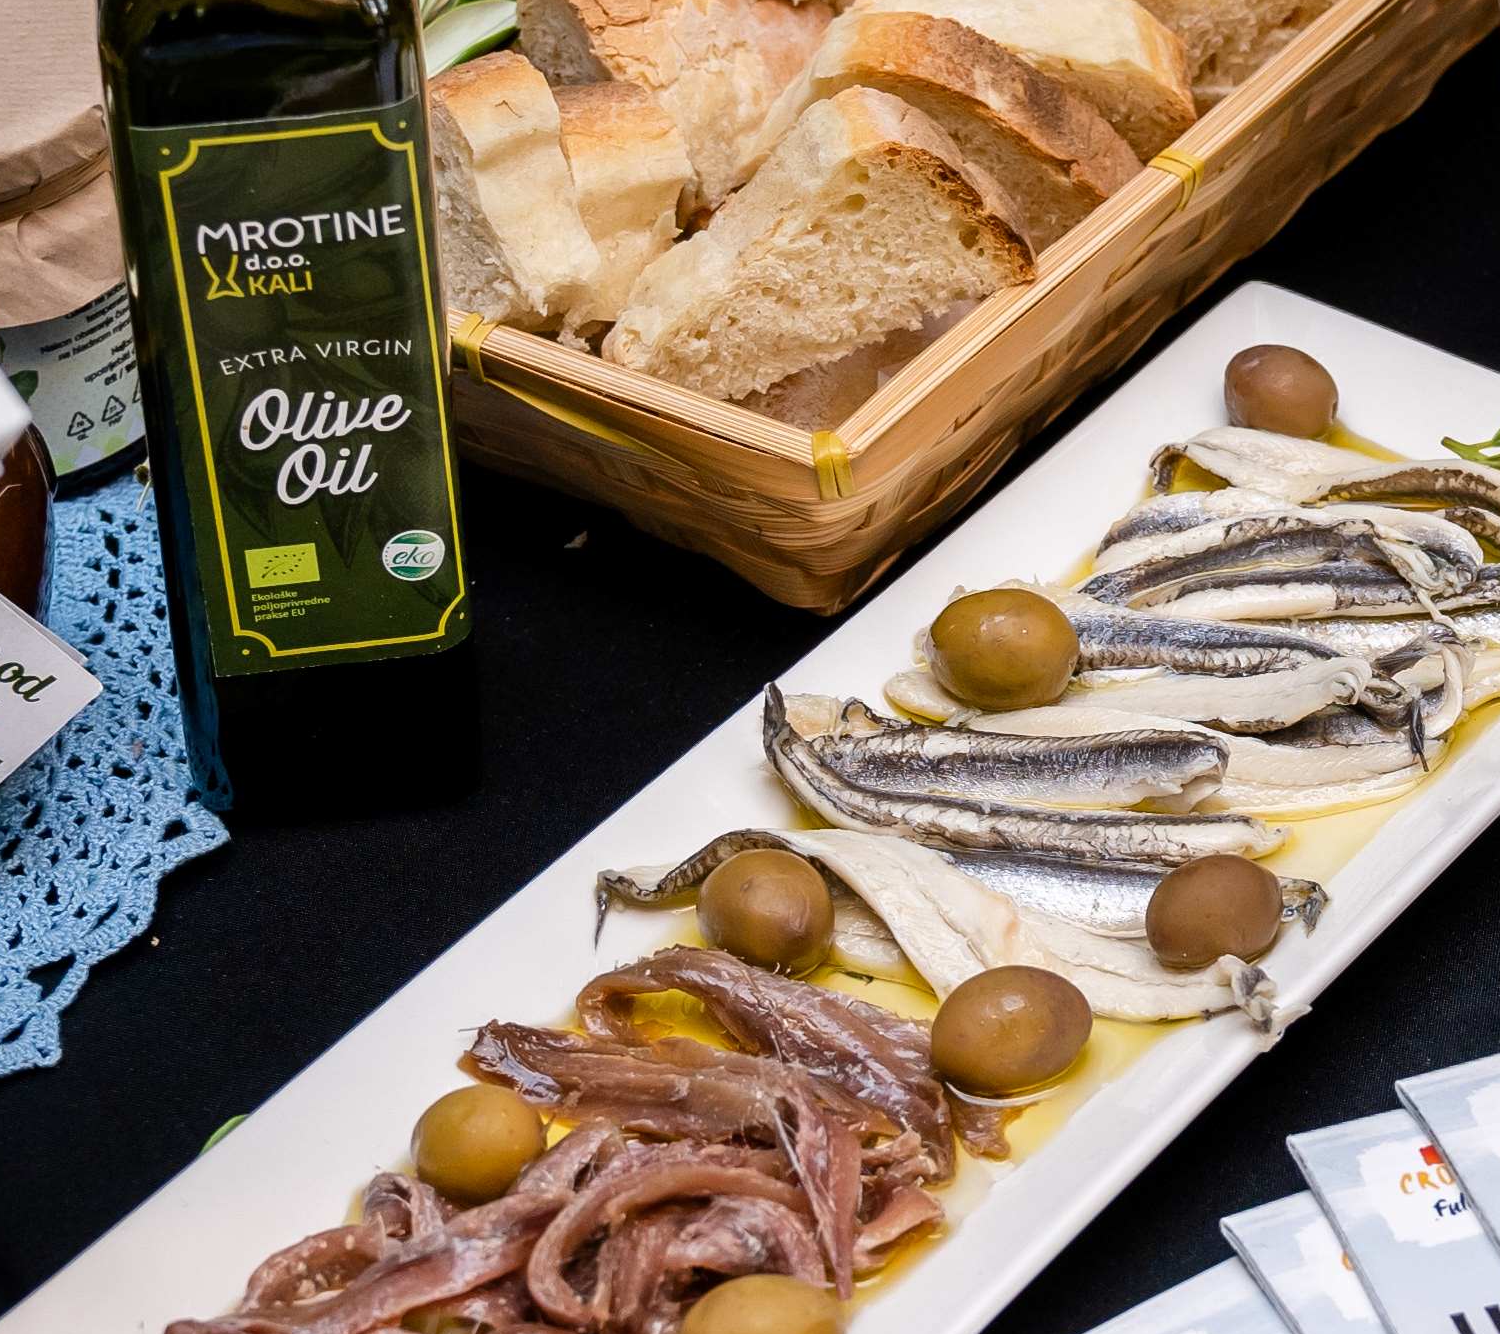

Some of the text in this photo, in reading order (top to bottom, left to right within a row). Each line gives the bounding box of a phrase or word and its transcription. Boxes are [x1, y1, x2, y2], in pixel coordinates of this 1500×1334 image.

[197, 204, 406, 255] MROTINE
[245, 253, 312, 272] d.o.o.
[249, 270, 314, 296] KALI
[220, 339, 413, 376] EXTRA VIRGIN
[240, 388, 413, 451] Olive
[277, 443, 379, 505] Oil
[392, 547, 435, 565] eko
[251, 589, 298, 602] Ekološke
[253, 595, 331, 613] poljoprivredne
[255, 607, 306, 622] prakse EU
